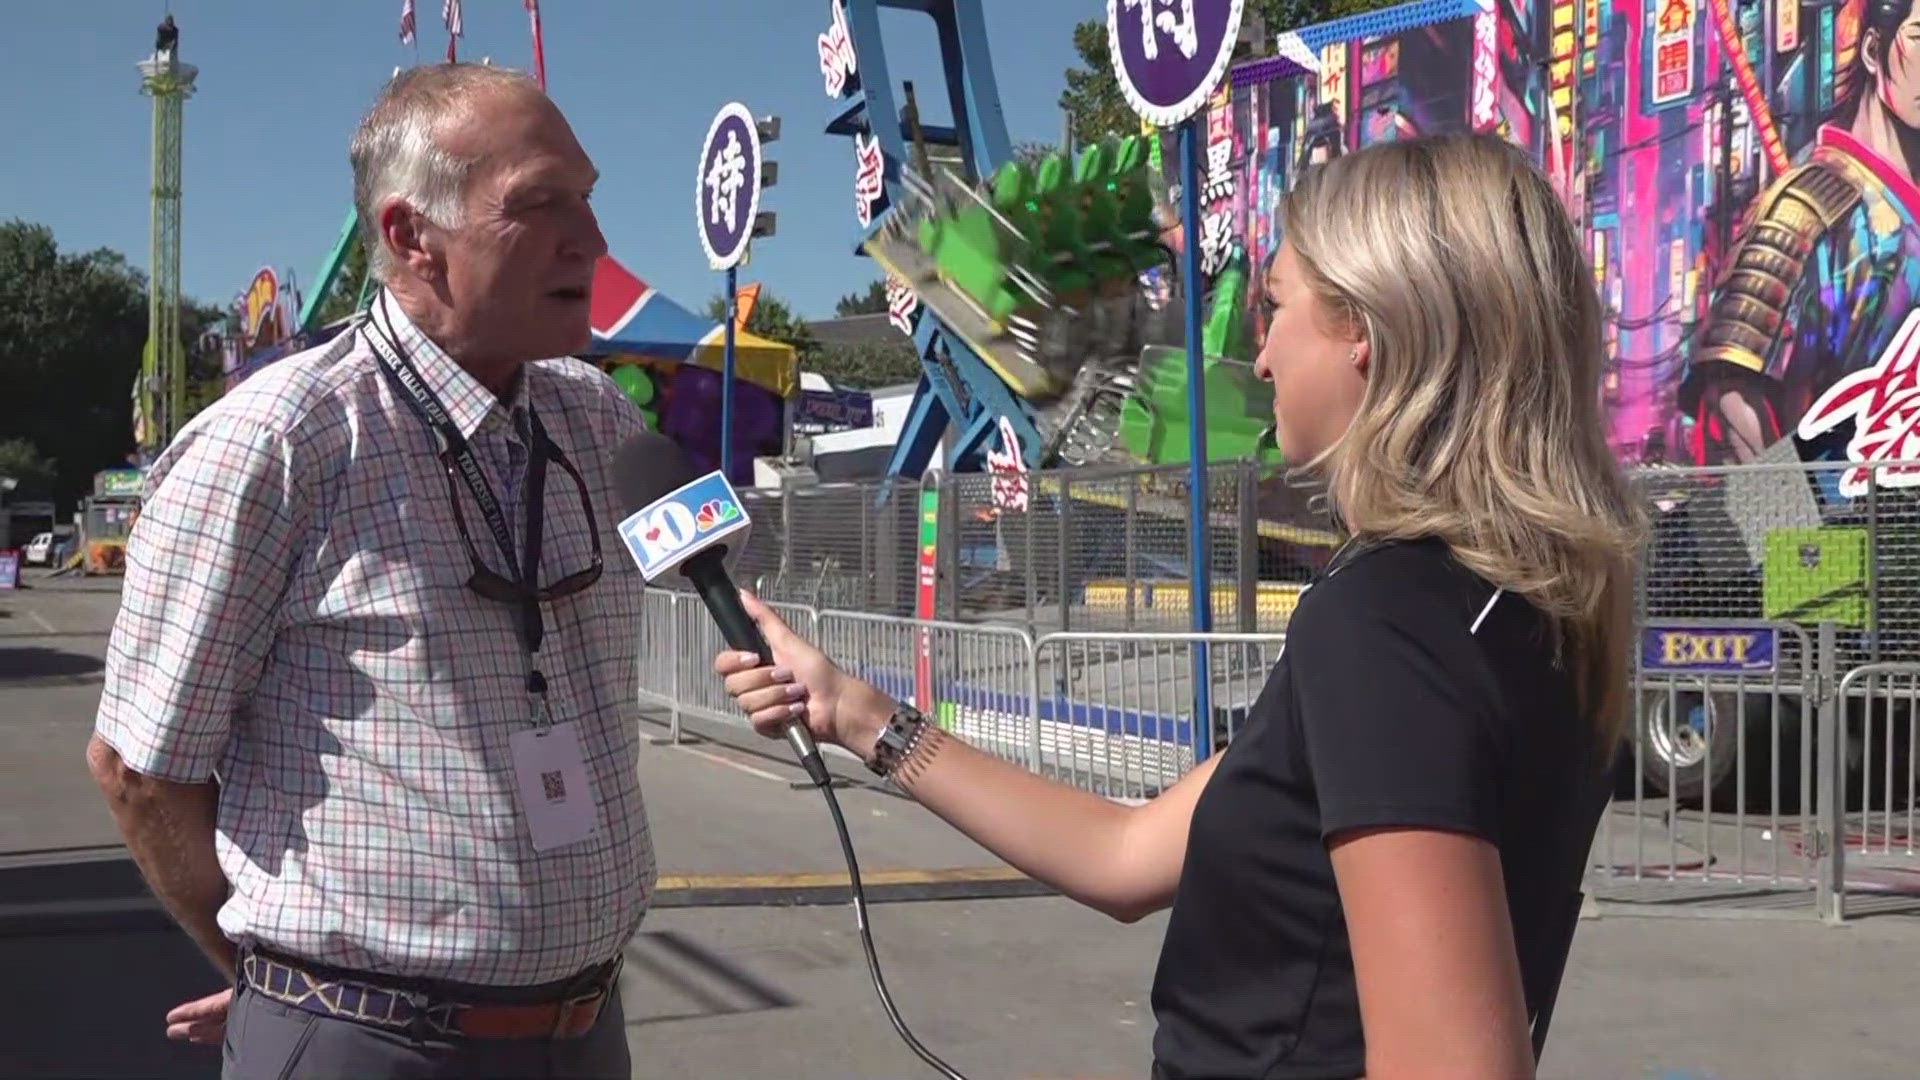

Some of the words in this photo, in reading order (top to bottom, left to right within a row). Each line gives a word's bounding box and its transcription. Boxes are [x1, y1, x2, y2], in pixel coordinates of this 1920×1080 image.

[705, 129, 746, 235] 侍
[397, 365, 430, 403] VALLEY
[425, 402, 448, 425] FAIR
[1659, 631, 1754, 664] EXIT
